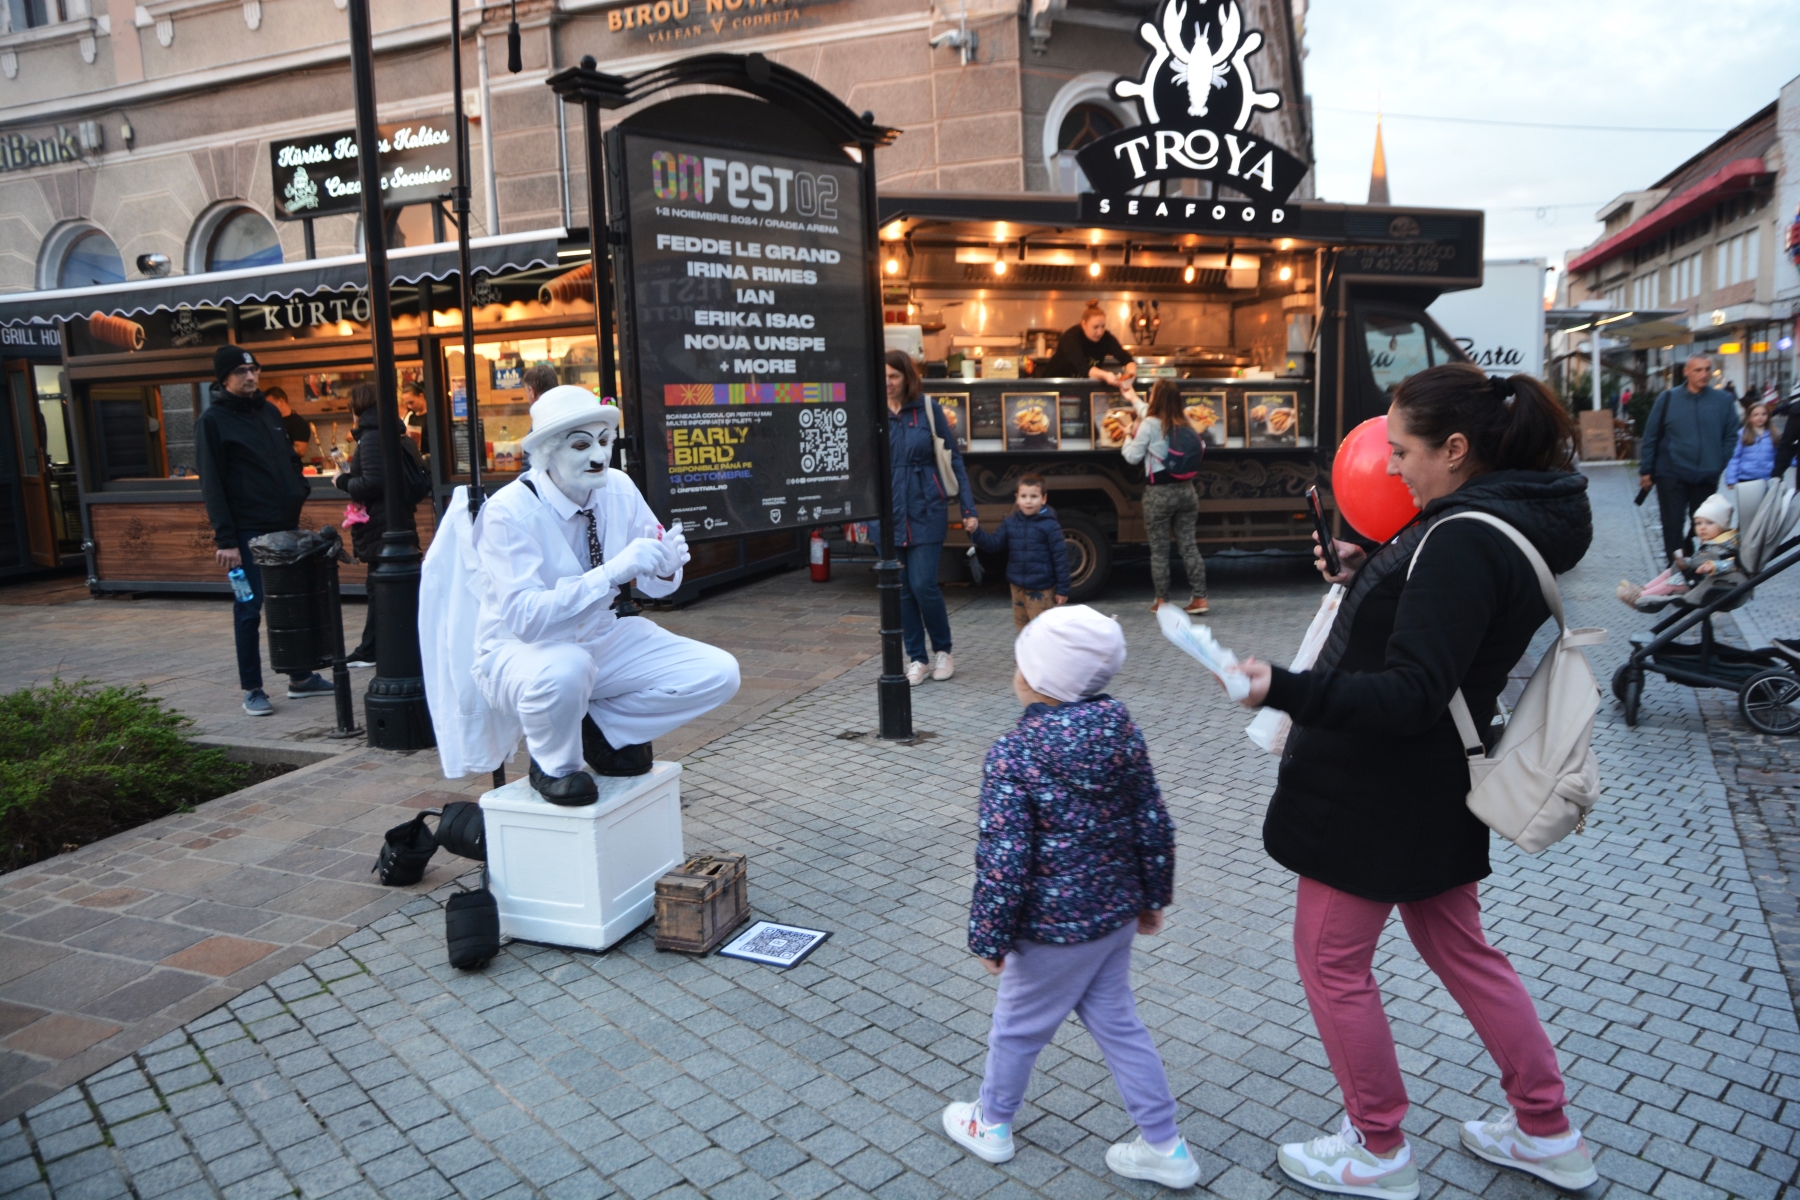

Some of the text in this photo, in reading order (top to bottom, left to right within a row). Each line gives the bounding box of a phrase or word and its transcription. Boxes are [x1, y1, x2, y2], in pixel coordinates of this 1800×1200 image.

[608, 0, 689, 32] BIROU
[1114, 129, 1274, 192] TROYA
[1099, 198, 1285, 223] SEAFOOD
[672, 208, 729, 223] NOIEMBRIE
[730, 215, 758, 226] 2024
[765, 218, 805, 231] ORADEA
[806, 224, 839, 234] ARENA
[657, 233, 841, 265] FEDDE LE GRAND
[687, 261, 818, 285] IRINA RIMES
[737, 288, 775, 305] IAN
[695, 310, 762, 328] ERIKA
[766, 313, 815, 329] ISAC
[1, 328, 37, 345] GRILL
[684, 333, 826, 352] NOUA UNSPE
[734, 359, 796, 374] MORE
[673, 426, 749, 447] EARLY
[674, 445, 735, 465] BIRD
[669, 464, 719, 474] DISPONIBILE
[669, 474, 682, 484] 13
